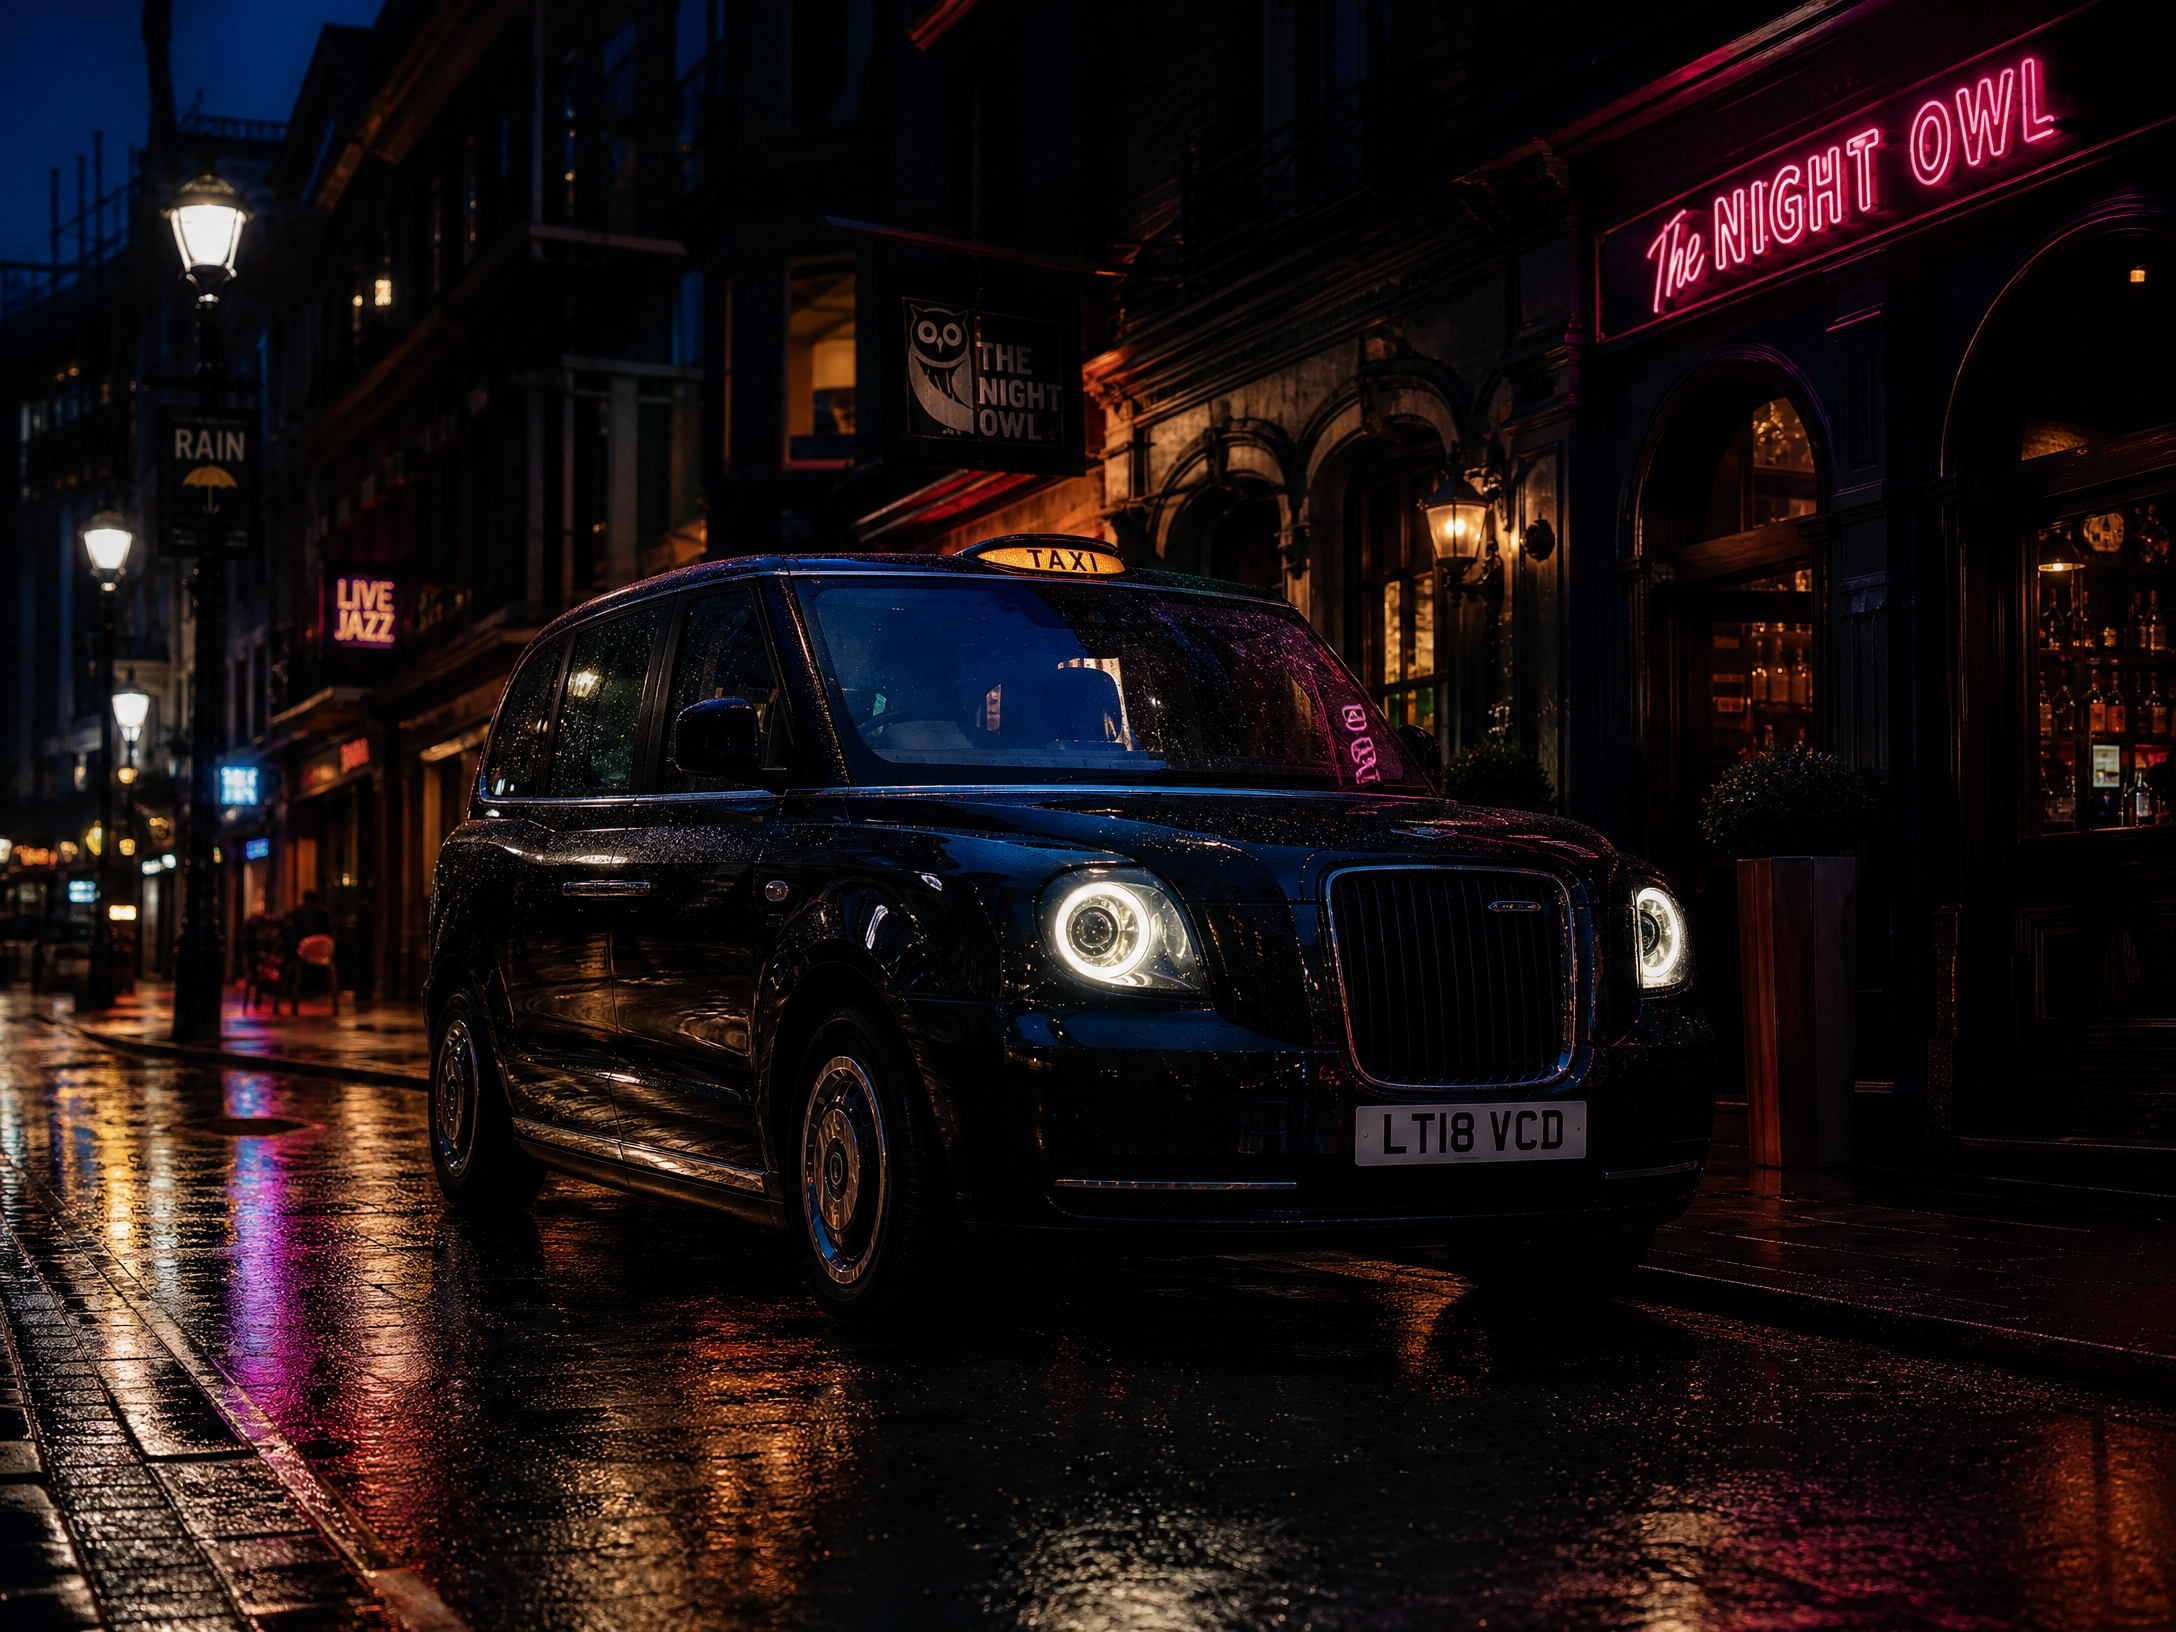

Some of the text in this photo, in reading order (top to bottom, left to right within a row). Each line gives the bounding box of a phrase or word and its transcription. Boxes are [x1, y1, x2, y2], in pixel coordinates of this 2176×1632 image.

[1646, 57, 2056, 314] The NIGHT OWL
[976, 341, 1033, 376] THE
[978, 376, 1063, 412] NIGHT
[979, 408, 1043, 441] OWL
[173, 427, 246, 463] RAIN
[1026, 549, 1098, 572] TAXI
[336, 578, 395, 612] LIVE
[333, 609, 396, 643] JAZZ
[1383, 1109, 1564, 1155] LT18 VCD
